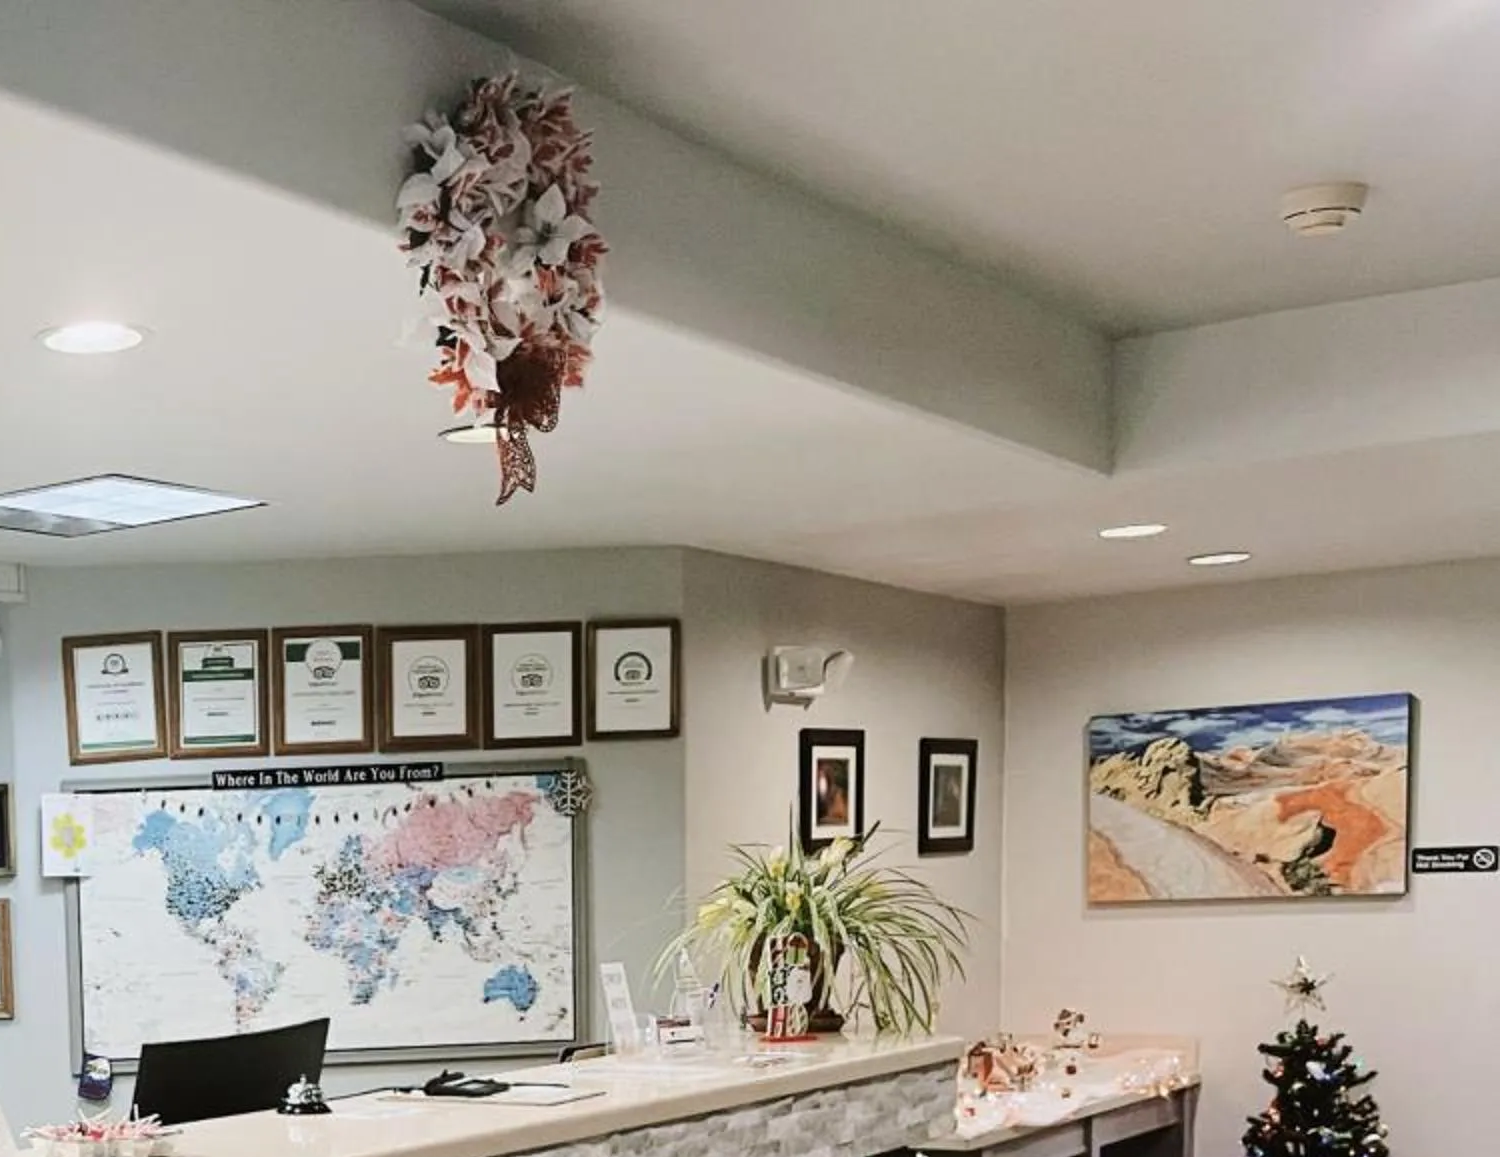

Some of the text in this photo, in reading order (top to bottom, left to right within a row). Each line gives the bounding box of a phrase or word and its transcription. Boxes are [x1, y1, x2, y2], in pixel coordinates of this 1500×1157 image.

[216, 764, 439, 787] Where In The World Are You From?
